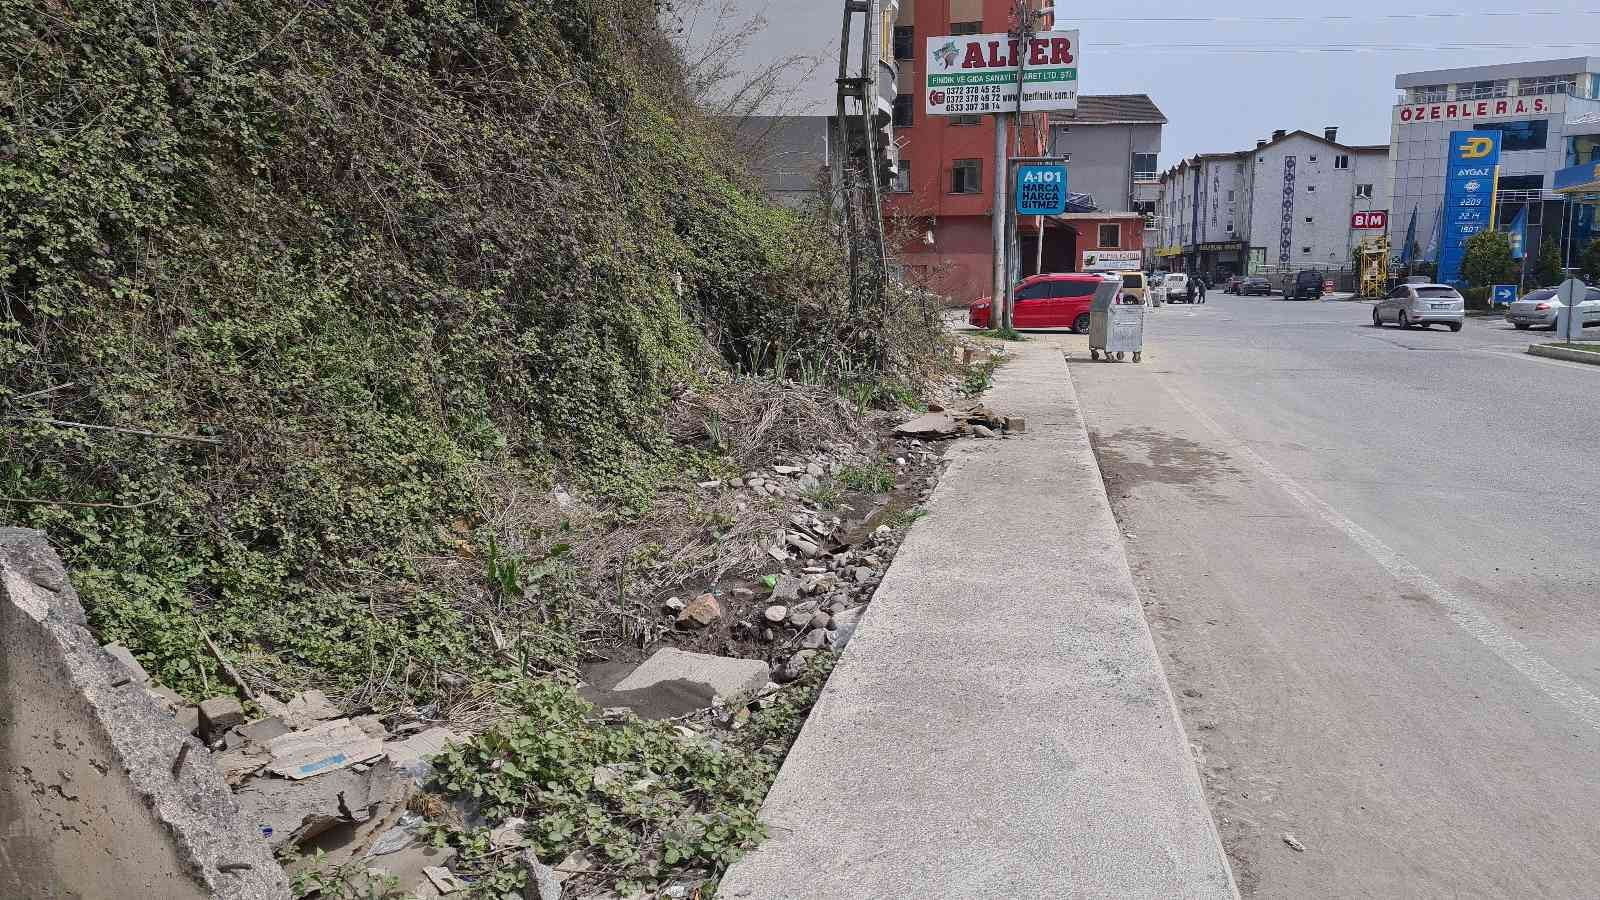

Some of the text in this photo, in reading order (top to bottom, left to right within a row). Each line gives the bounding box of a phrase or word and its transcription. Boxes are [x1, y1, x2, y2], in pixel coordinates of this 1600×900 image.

[956, 75, 966, 83] VE
[967, 75, 984, 83] GIDA
[946, 85, 1001, 95] 0372 378 45 25
[946, 95, 964, 104] 0372
[991, 94, 1001, 102] 72
[945, 103, 964, 112] 0533
[1400, 101, 1508, 122] ÖZERLER
[1457, 168, 1489, 176] AYGAZ
